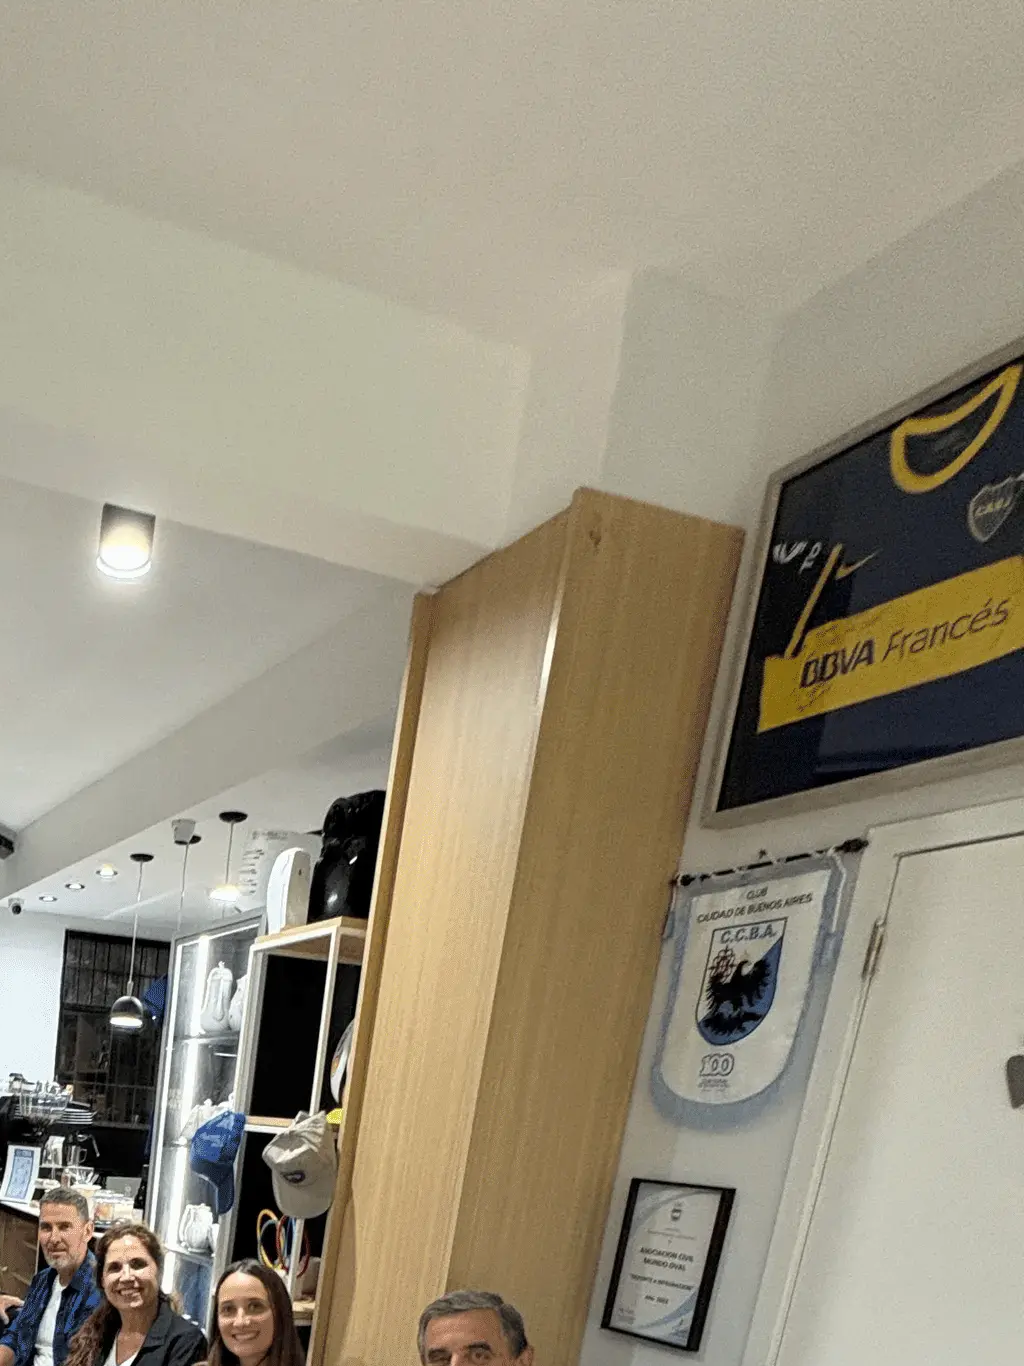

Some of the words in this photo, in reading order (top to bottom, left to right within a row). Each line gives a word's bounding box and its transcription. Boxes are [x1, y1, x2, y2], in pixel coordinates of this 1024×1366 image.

[800, 637, 875, 689] BBVA
[882, 597, 1013, 662] Francés
[734, 905, 746, 917] DE
[747, 898, 784, 915] BUENOS
[783, 891, 814, 908] AIRES
